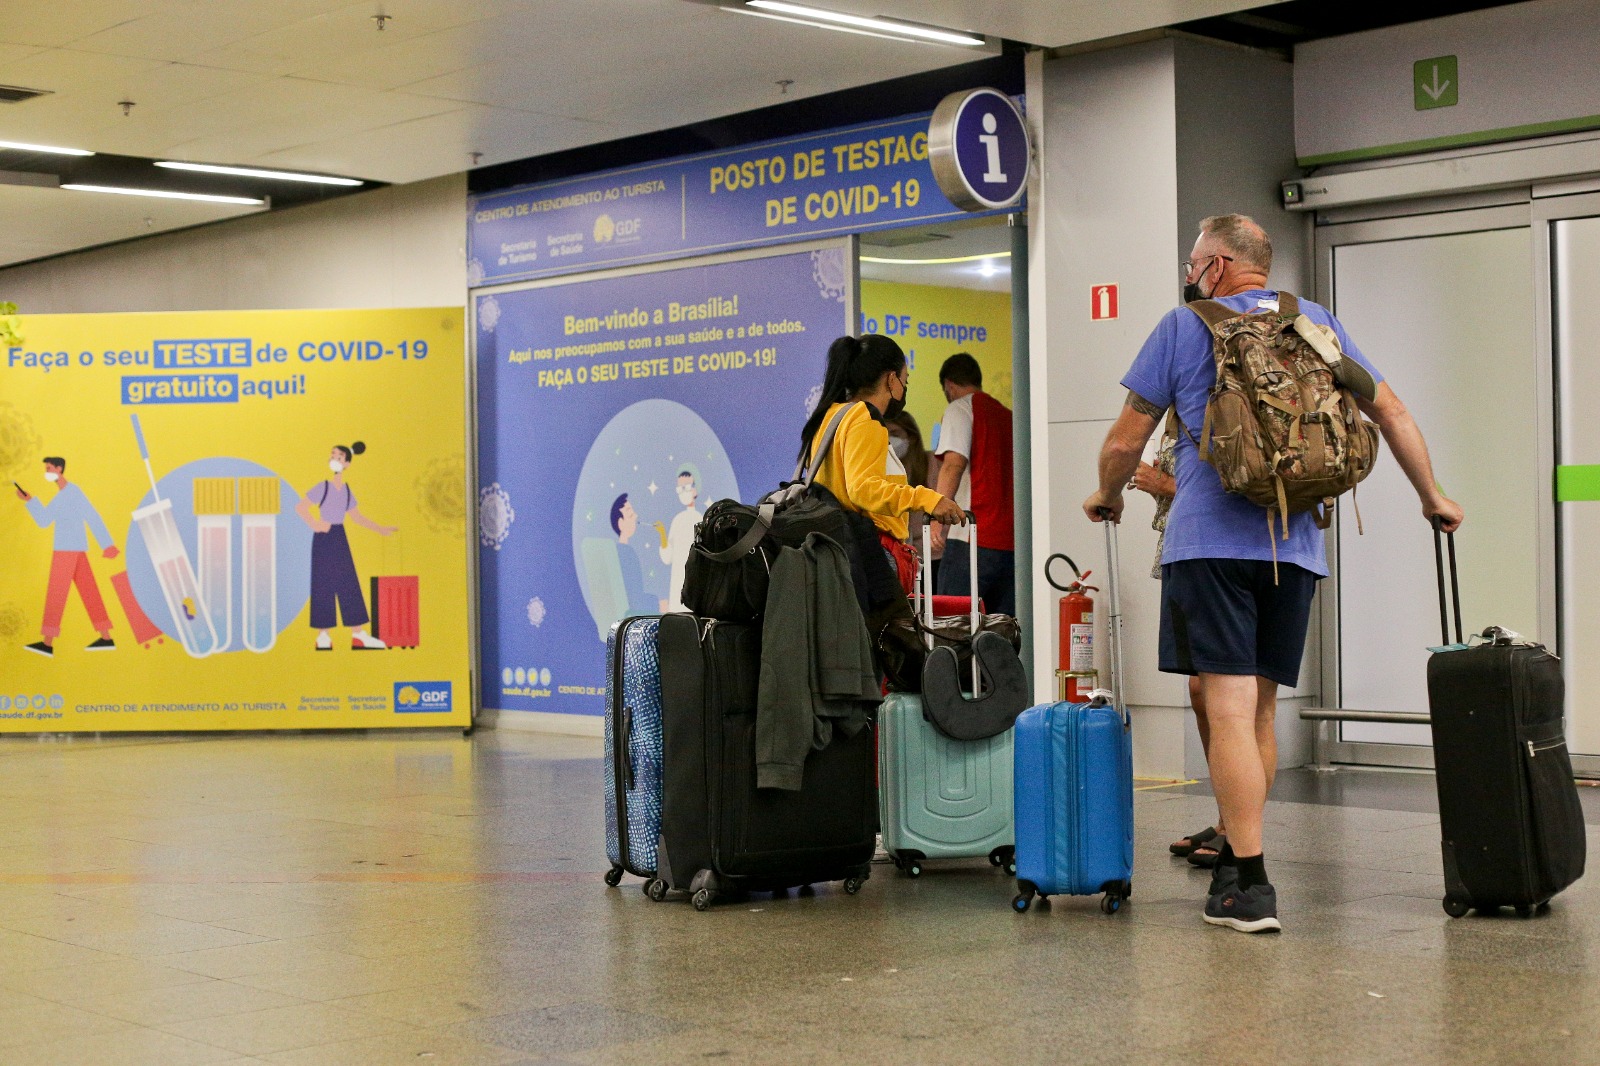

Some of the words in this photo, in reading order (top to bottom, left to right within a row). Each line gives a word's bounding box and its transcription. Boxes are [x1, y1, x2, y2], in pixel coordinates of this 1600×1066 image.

[710, 156, 786, 194] POSTO
[793, 149, 826, 180] DE
[476, 205, 515, 224] CENTRO
[515, 203, 529, 217] DE
[531, 191, 602, 213] ATENDIMENTO
[604, 187, 620, 201] AO
[622, 180, 666, 198] TURISTA
[766, 196, 798, 228] DE
[804, 179, 920, 221] COVID-19
[616, 218, 641, 236] GDF
[564, 307, 649, 336] Bem-vindo
[653, 309, 664, 325] a
[668, 294, 738, 323] Brasília!
[885, 314, 911, 336] DF
[917, 321, 988, 345] sempre
[8, 347, 69, 373] Faça
[79, 351, 94, 366] o
[103, 350, 149, 365] seu
[157, 342, 248, 366] TESTE
[256, 343, 288, 363] de
[298, 340, 428, 362] COVID-19
[508, 347, 531, 365] Aqui
[533, 348, 553, 360] nos
[555, 340, 625, 361] preocupamos
[628, 335, 652, 349] com
[654, 336, 663, 347] a
[665, 333, 685, 346] sua
[688, 325, 724, 343] saúde
[726, 328, 735, 339] e
[737, 326, 745, 338] a
[748, 322, 763, 337] de
[766, 319, 806, 335] todos.
[538, 368, 574, 390] FAÇA
[576, 366, 588, 384] O
[590, 363, 619, 383] SEU
[622, 357, 669, 379] TESTE
[672, 355, 695, 374] DE
[698, 347, 777, 372] COVID-19!
[127, 376, 233, 403] gratuito
[242, 375, 306, 399] aqui!
[75, 703, 121, 713] CENTRO
[123, 703, 138, 712] DE
[141, 702, 219, 712] ATENDIMENTO
[223, 703, 239, 711] AO
[242, 702, 287, 711] TURISTA
[301, 695, 339, 704] Secretaria
[348, 695, 386, 703] Secretaria
[421, 691, 448, 703] GDF
